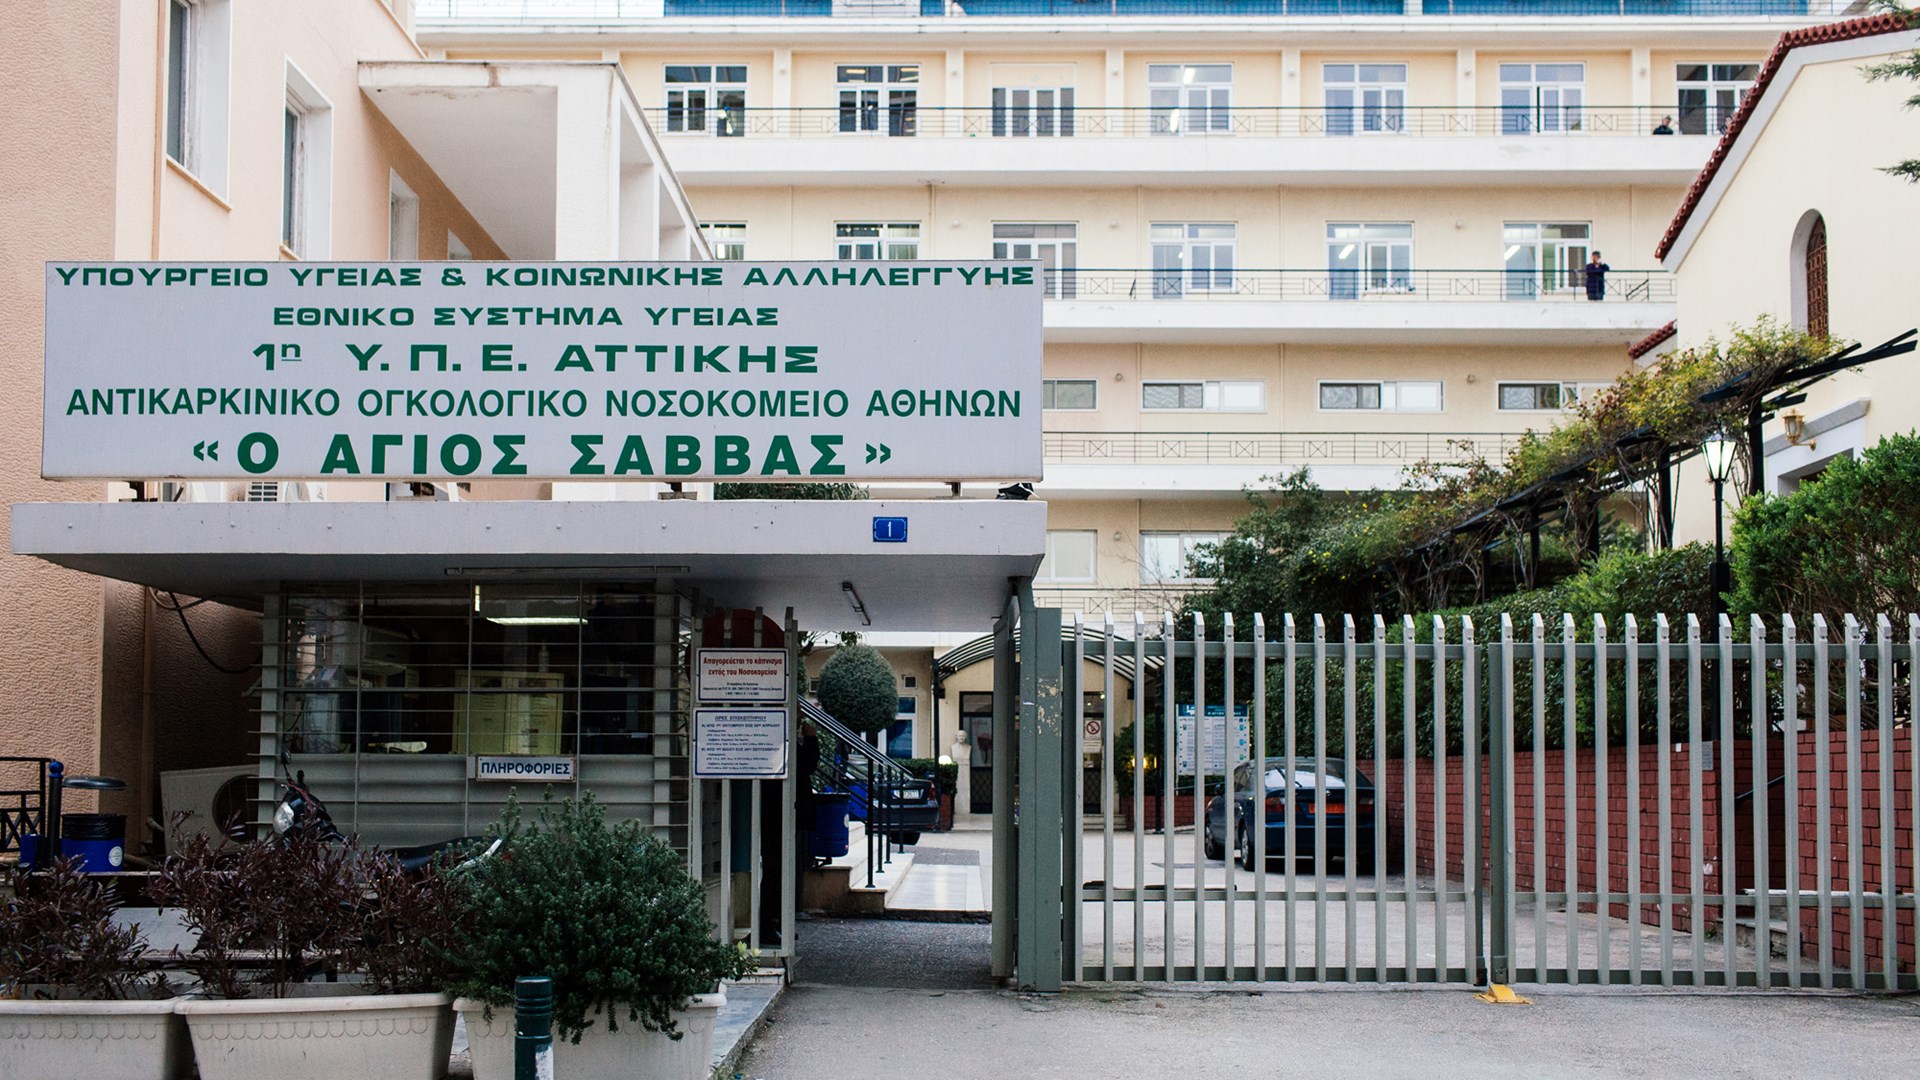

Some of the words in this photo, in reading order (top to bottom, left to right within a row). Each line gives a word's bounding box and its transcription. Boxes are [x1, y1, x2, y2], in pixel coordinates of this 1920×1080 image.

[55, 267, 268, 287] ΥΠΟΥΡΓΕΙΟ
[288, 267, 421, 287] ΥΓΕΙΑΣ
[440, 267, 465, 287] &
[486, 267, 723, 287] ΚΟΙΝΩΝΙΚΗΣ
[743, 266, 1035, 287] ΑΛΛΗΛΕΓΓΥΗΣ
[273, 306, 414, 327] ΕΘΝΙΚΟ
[433, 306, 623, 326] ΣΥΣΤΗΜΑ
[644, 307, 779, 327] ΥΓΕΙΑΣ
[554, 344, 819, 374] ΑΤΤΙΚΗΣ
[66, 387, 340, 417] ΑΝΤΙΚΑΡΚΙΝΙΚΟ
[357, 388, 588, 418] ΟΓΚΟΛΟΓΙΚΟ
[605, 389, 849, 418] ΝΟΣΟΚΟΜΕΙΟ
[865, 388, 1021, 418] ΑΘΗΝΩΝ
[319, 433, 528, 476] ΑΓΙΟΣ
[887, 520, 892, 538] 1
[703, 656, 745, 666] Απαγορεύεται
[754, 657, 783, 666] κάπνισμα
[708, 668, 725, 677] εντός
[738, 668, 778, 677] Νοσοκομείου
[481, 762, 571, 775] ΠΛΗΡΟΦΟΡΙΕΣ
